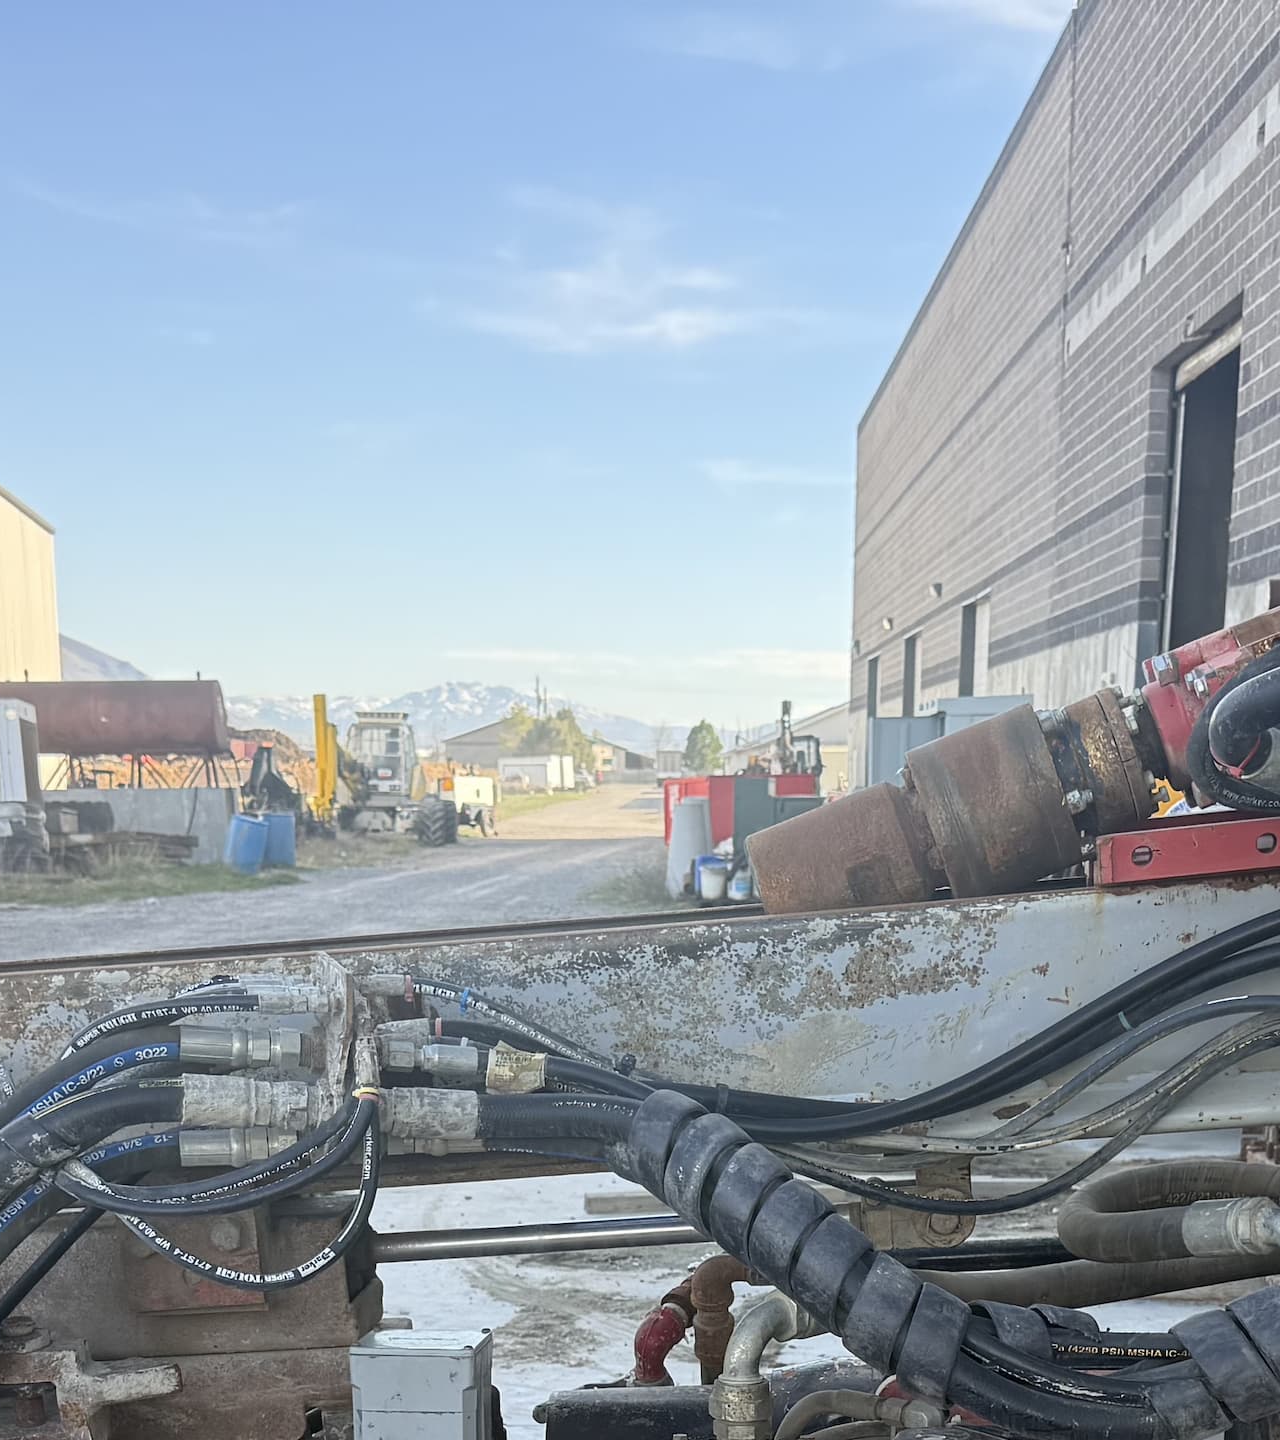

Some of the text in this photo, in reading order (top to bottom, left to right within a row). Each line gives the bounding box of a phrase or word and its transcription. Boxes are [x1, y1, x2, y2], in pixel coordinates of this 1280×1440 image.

[98, 1012, 138, 1033] TOUGH
[134, 1046, 169, 1062] 3Q22
[154, 1235, 172, 1251] WP
[173, 1246, 213, 1271] 471ST-4
[216, 1266, 264, 1284] TOUGH
[263, 1270, 296, 1283] SUPER
[1127, 1348, 1162, 1358] MSHA
